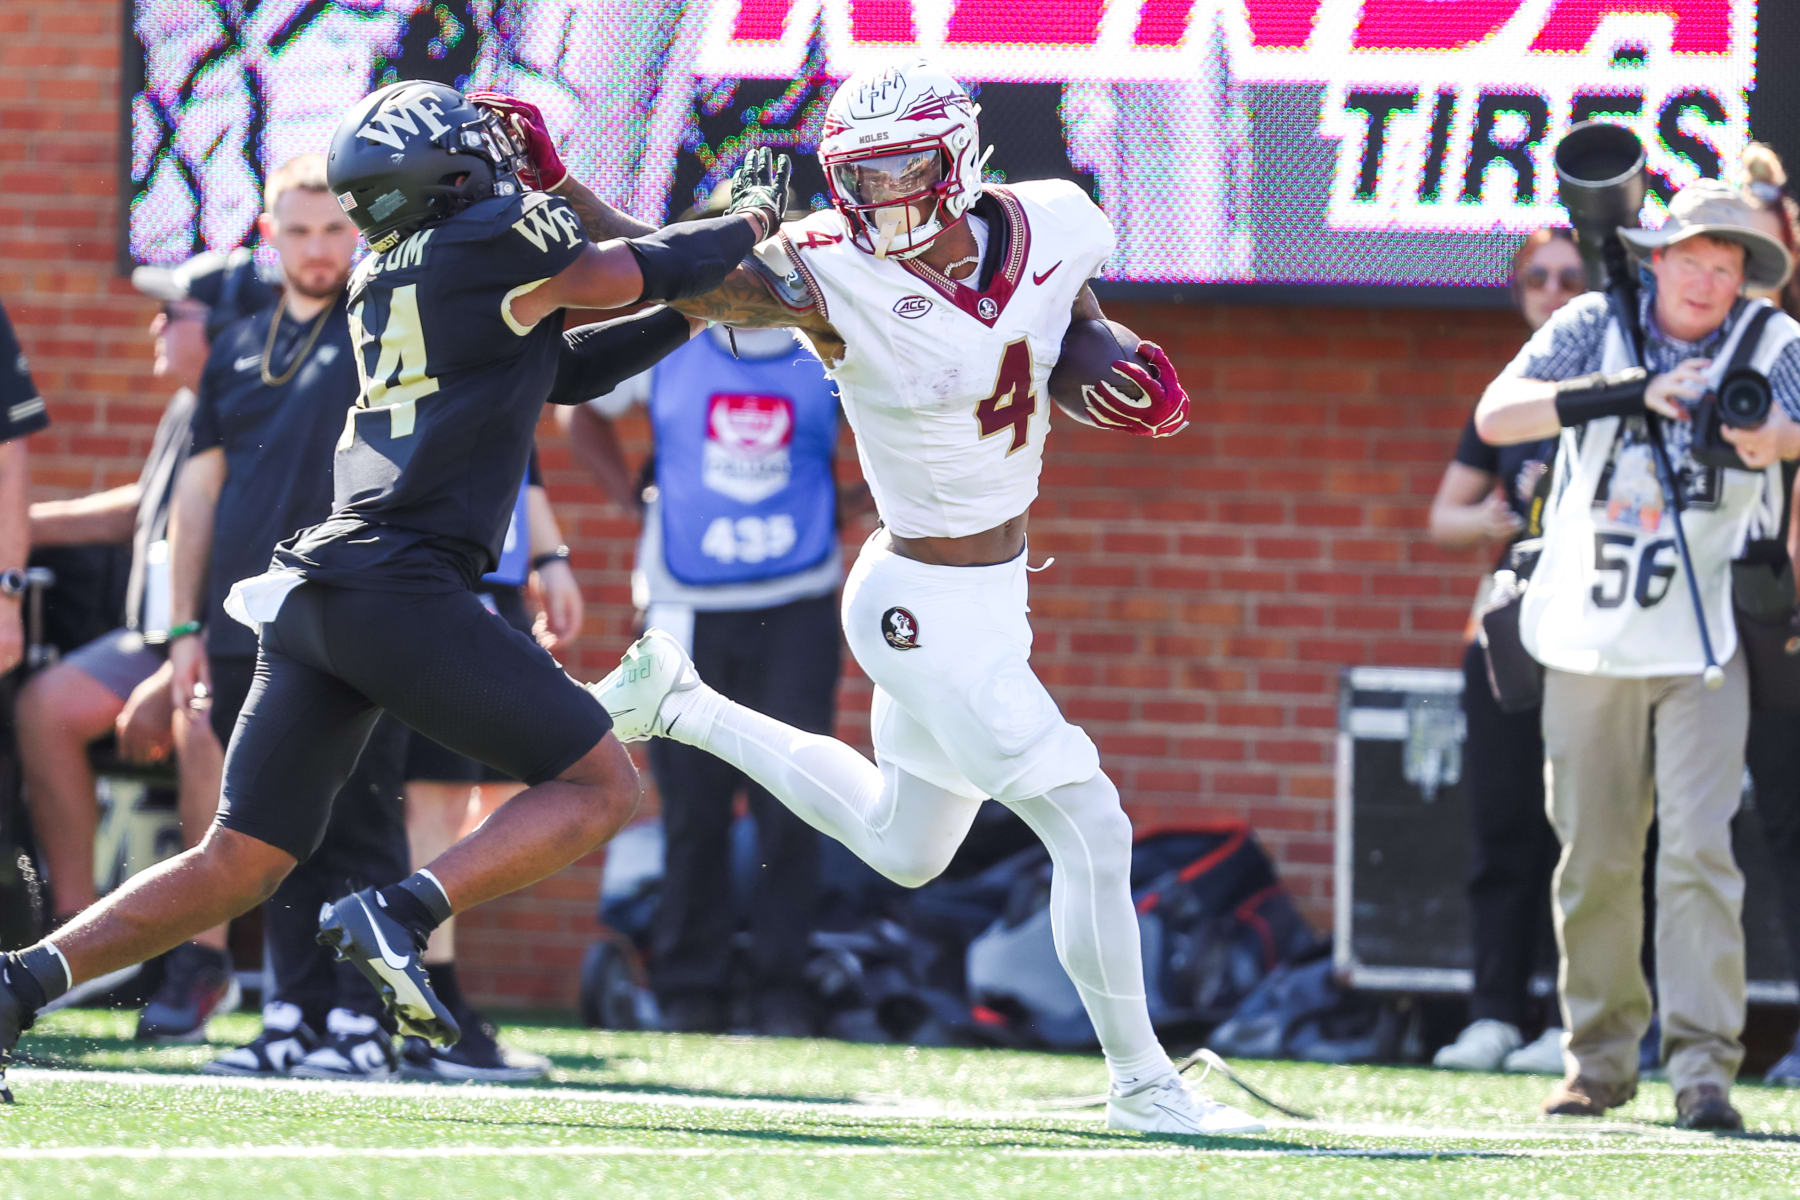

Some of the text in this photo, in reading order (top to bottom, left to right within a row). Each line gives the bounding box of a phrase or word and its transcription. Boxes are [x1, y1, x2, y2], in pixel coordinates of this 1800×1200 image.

[356, 91, 452, 150] WF
[859, 132, 889, 144] NOLES
[1345, 88, 1728, 206] TIRS
[511, 200, 582, 253] WF
[797, 231, 843, 249] 4
[973, 335, 1038, 459] 4
[1592, 532, 1680, 608] 56
